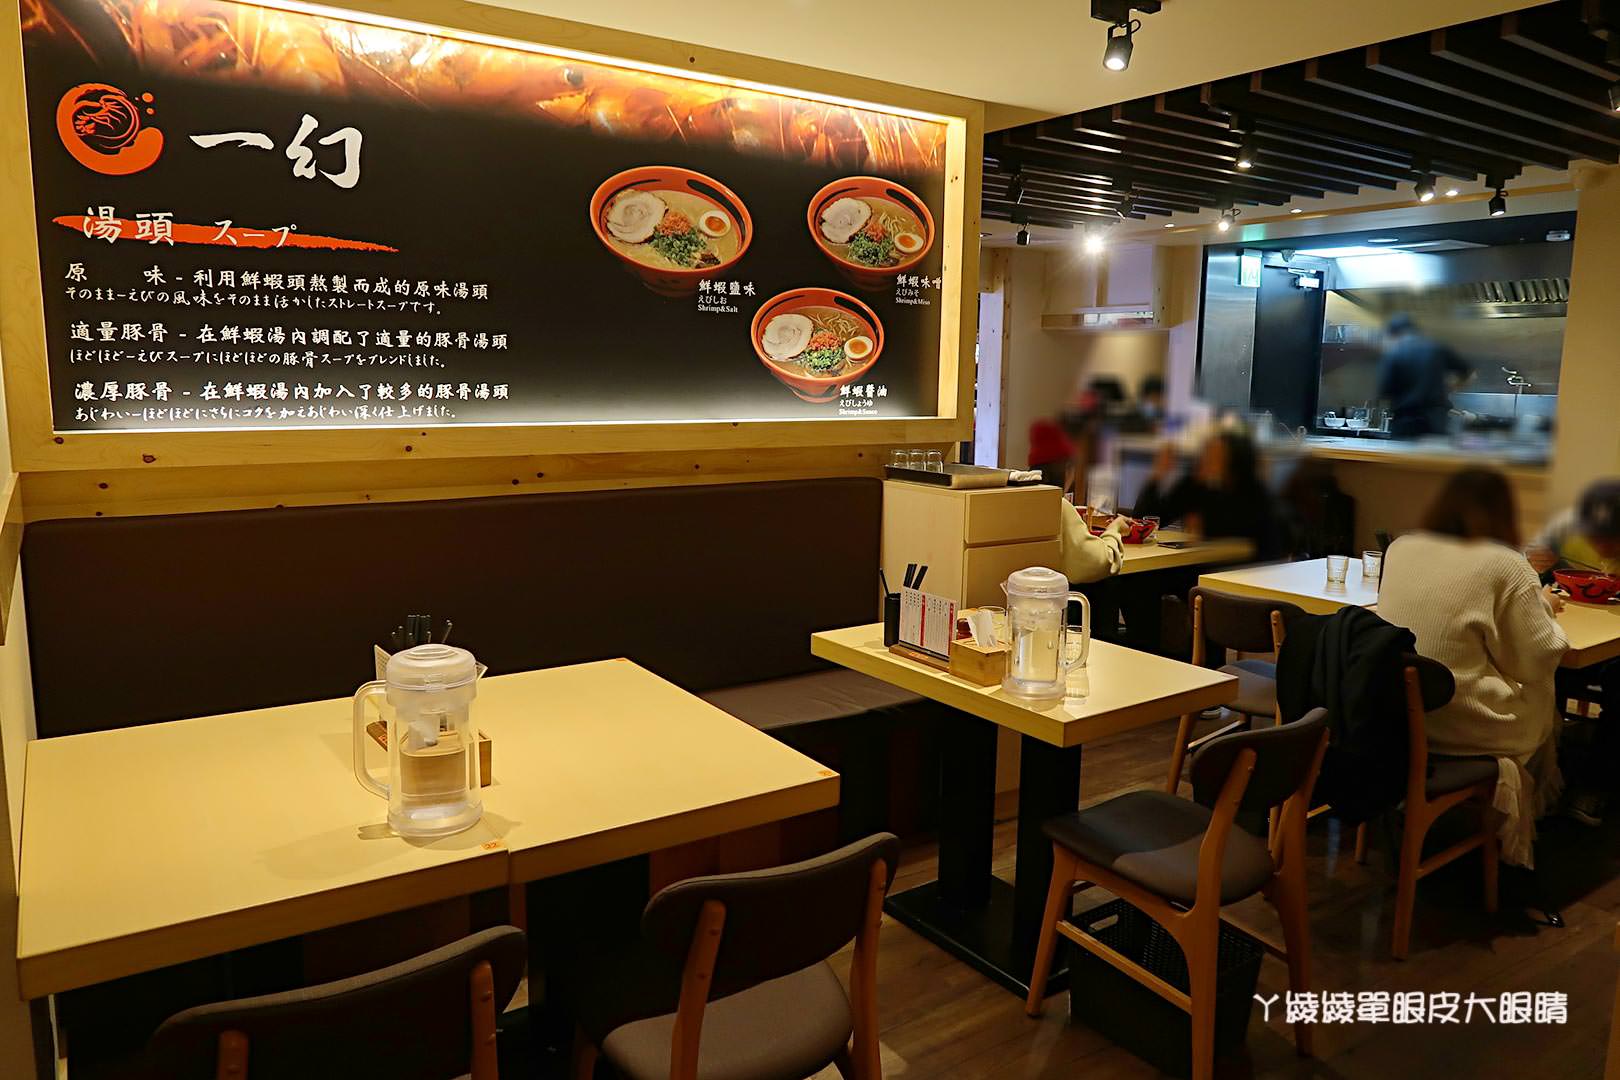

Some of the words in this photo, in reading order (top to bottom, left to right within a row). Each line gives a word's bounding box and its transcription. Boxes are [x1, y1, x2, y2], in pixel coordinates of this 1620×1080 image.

[188, 113, 363, 189] 一幻
[82, 206, 175, 246] 湯頭
[213, 220, 297, 248] スープ
[699, 279, 756, 296] 鮮蝦鹽味
[698, 295, 727, 305] えびしお
[698, 304, 738, 314] Shrimp&Salt
[70, 320, 168, 343] 適量豚骨
[74, 380, 173, 402] 濃厚豚骨
